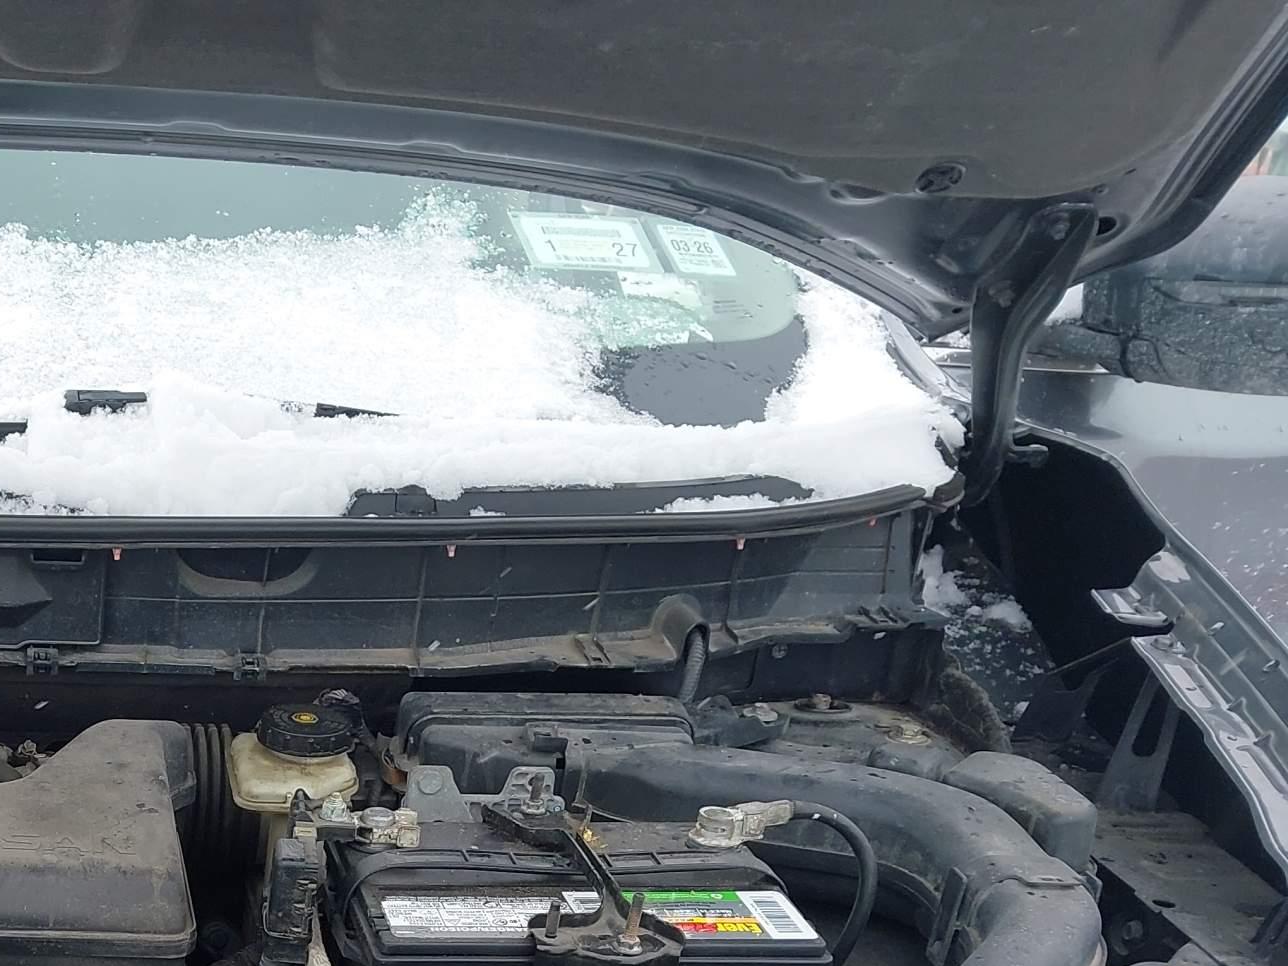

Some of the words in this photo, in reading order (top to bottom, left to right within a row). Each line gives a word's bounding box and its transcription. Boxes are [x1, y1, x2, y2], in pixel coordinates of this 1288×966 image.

[611, 242, 637, 257] 27
[670, 239, 690, 252] 03
[693, 240, 713, 254] 26
